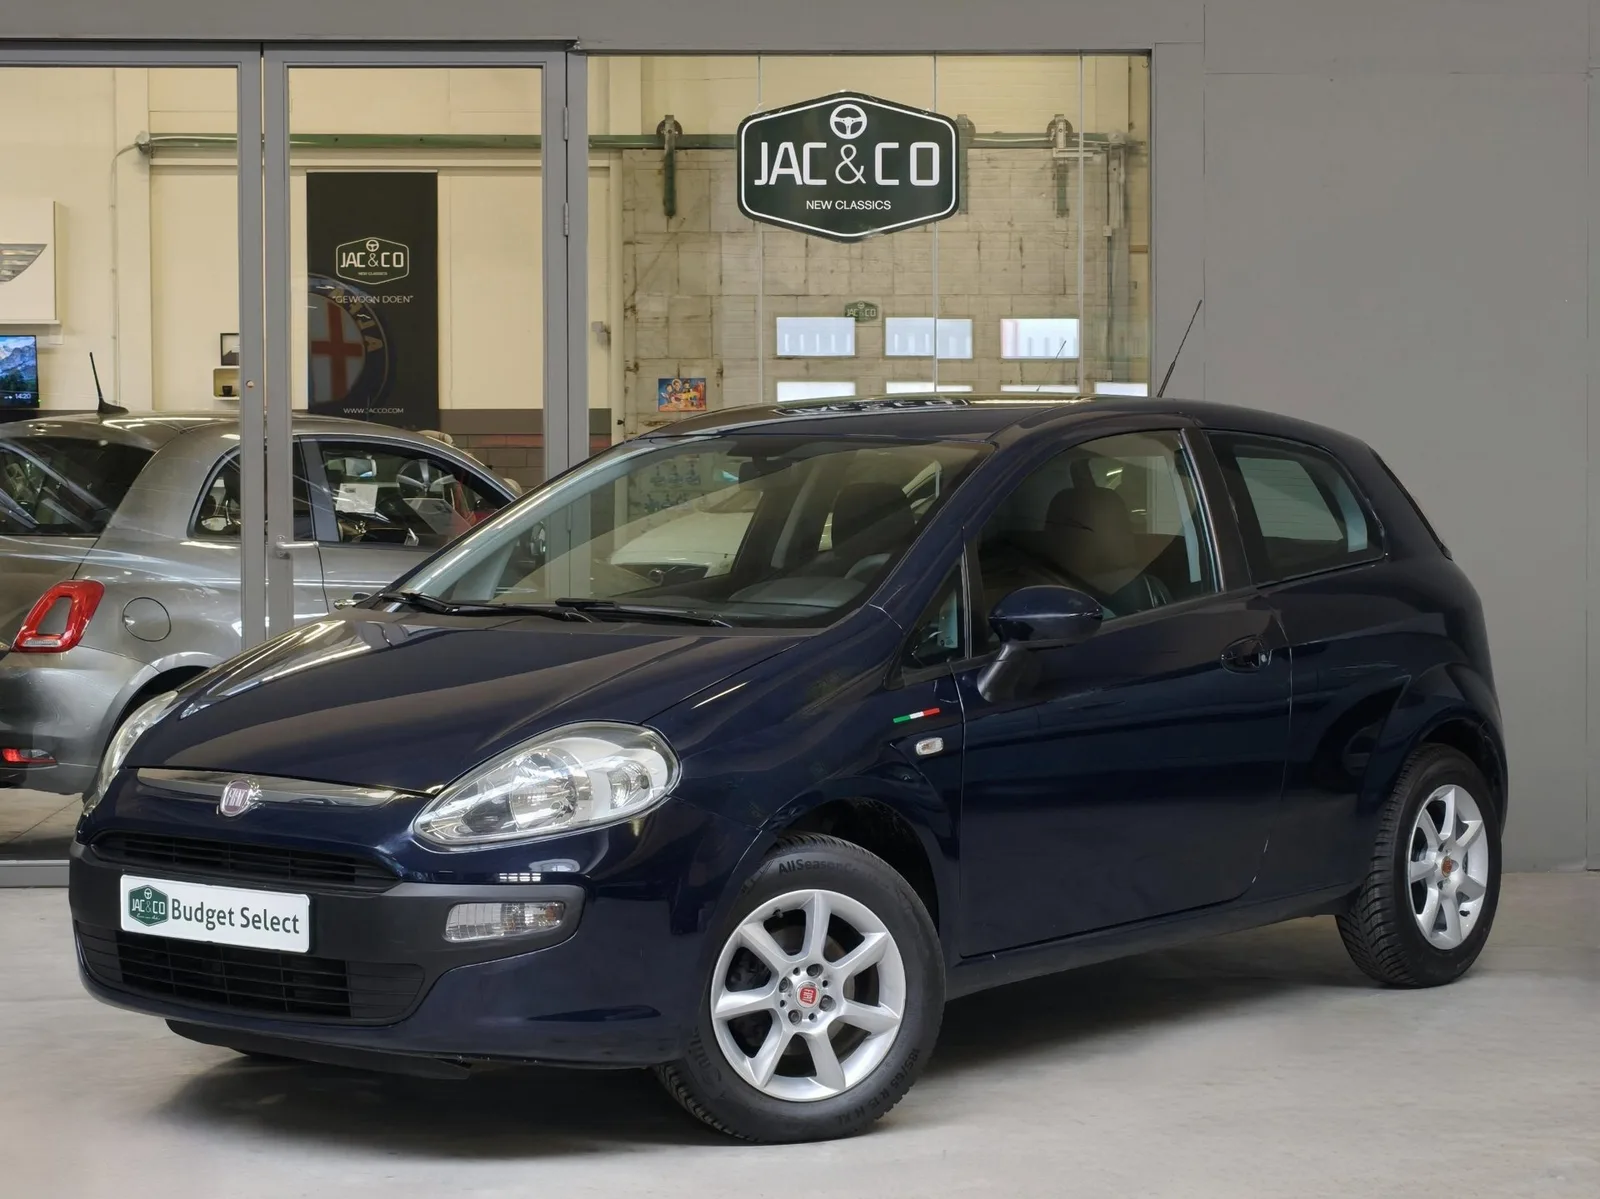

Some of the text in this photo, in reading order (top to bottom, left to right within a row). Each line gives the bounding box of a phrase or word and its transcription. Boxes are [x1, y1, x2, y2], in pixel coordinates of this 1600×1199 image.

[806, 200, 892, 210] NEW CLASSICS
[171, 898, 300, 935] Budget Select
